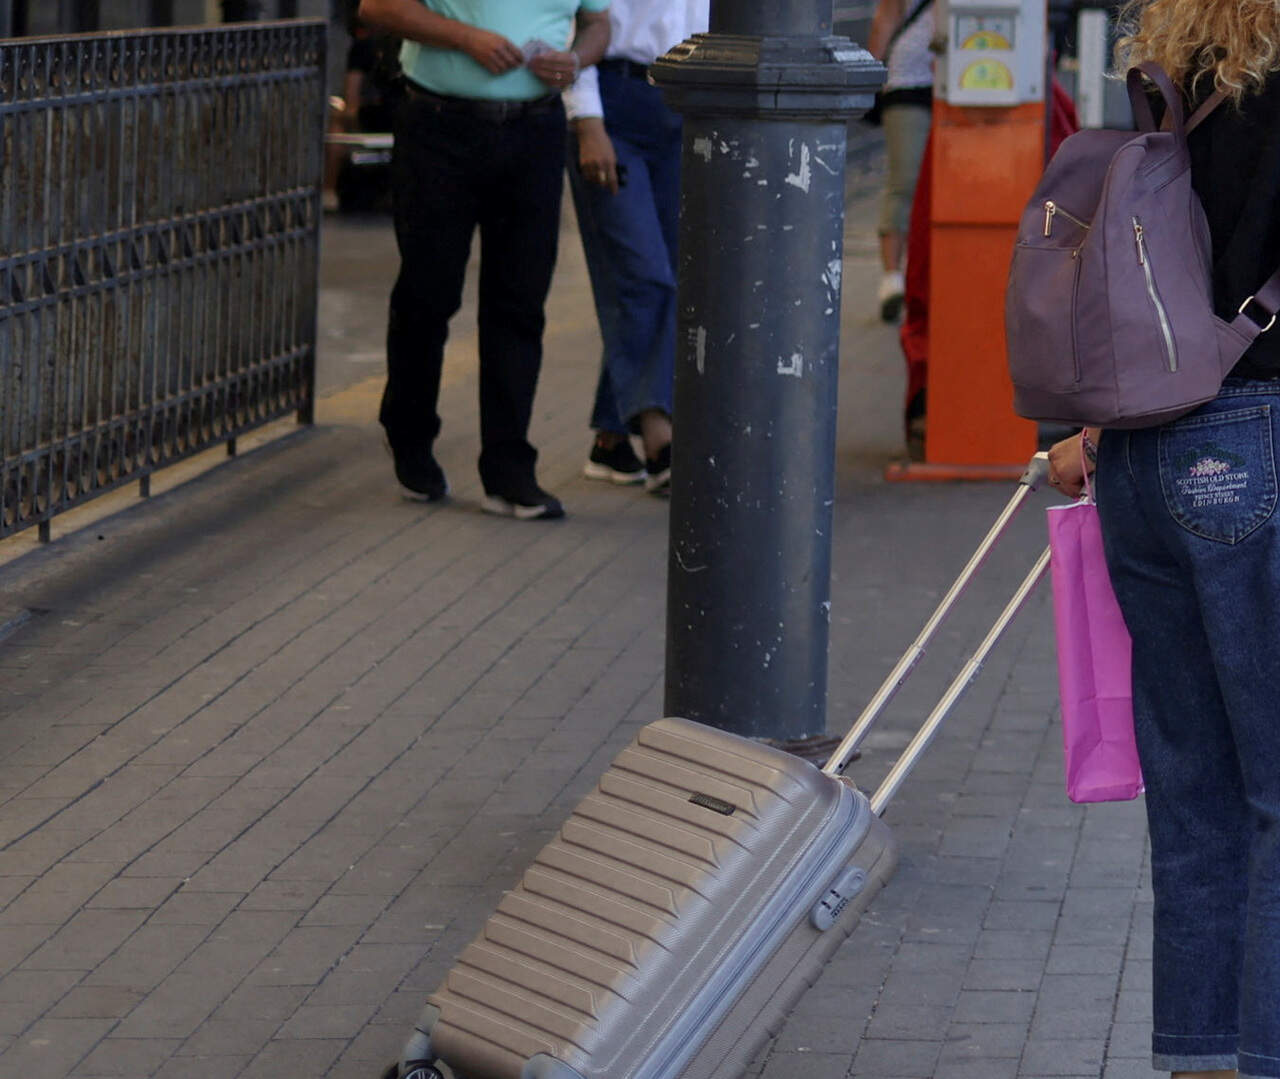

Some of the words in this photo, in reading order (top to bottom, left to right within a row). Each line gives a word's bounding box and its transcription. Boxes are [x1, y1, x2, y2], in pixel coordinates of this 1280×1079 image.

[1176, 477, 1209, 486] SCOTTISH
[1210, 475, 1224, 483] OLD
[1225, 472, 1248, 480] STORE
[1193, 496, 1240, 507] EDINBURGH
